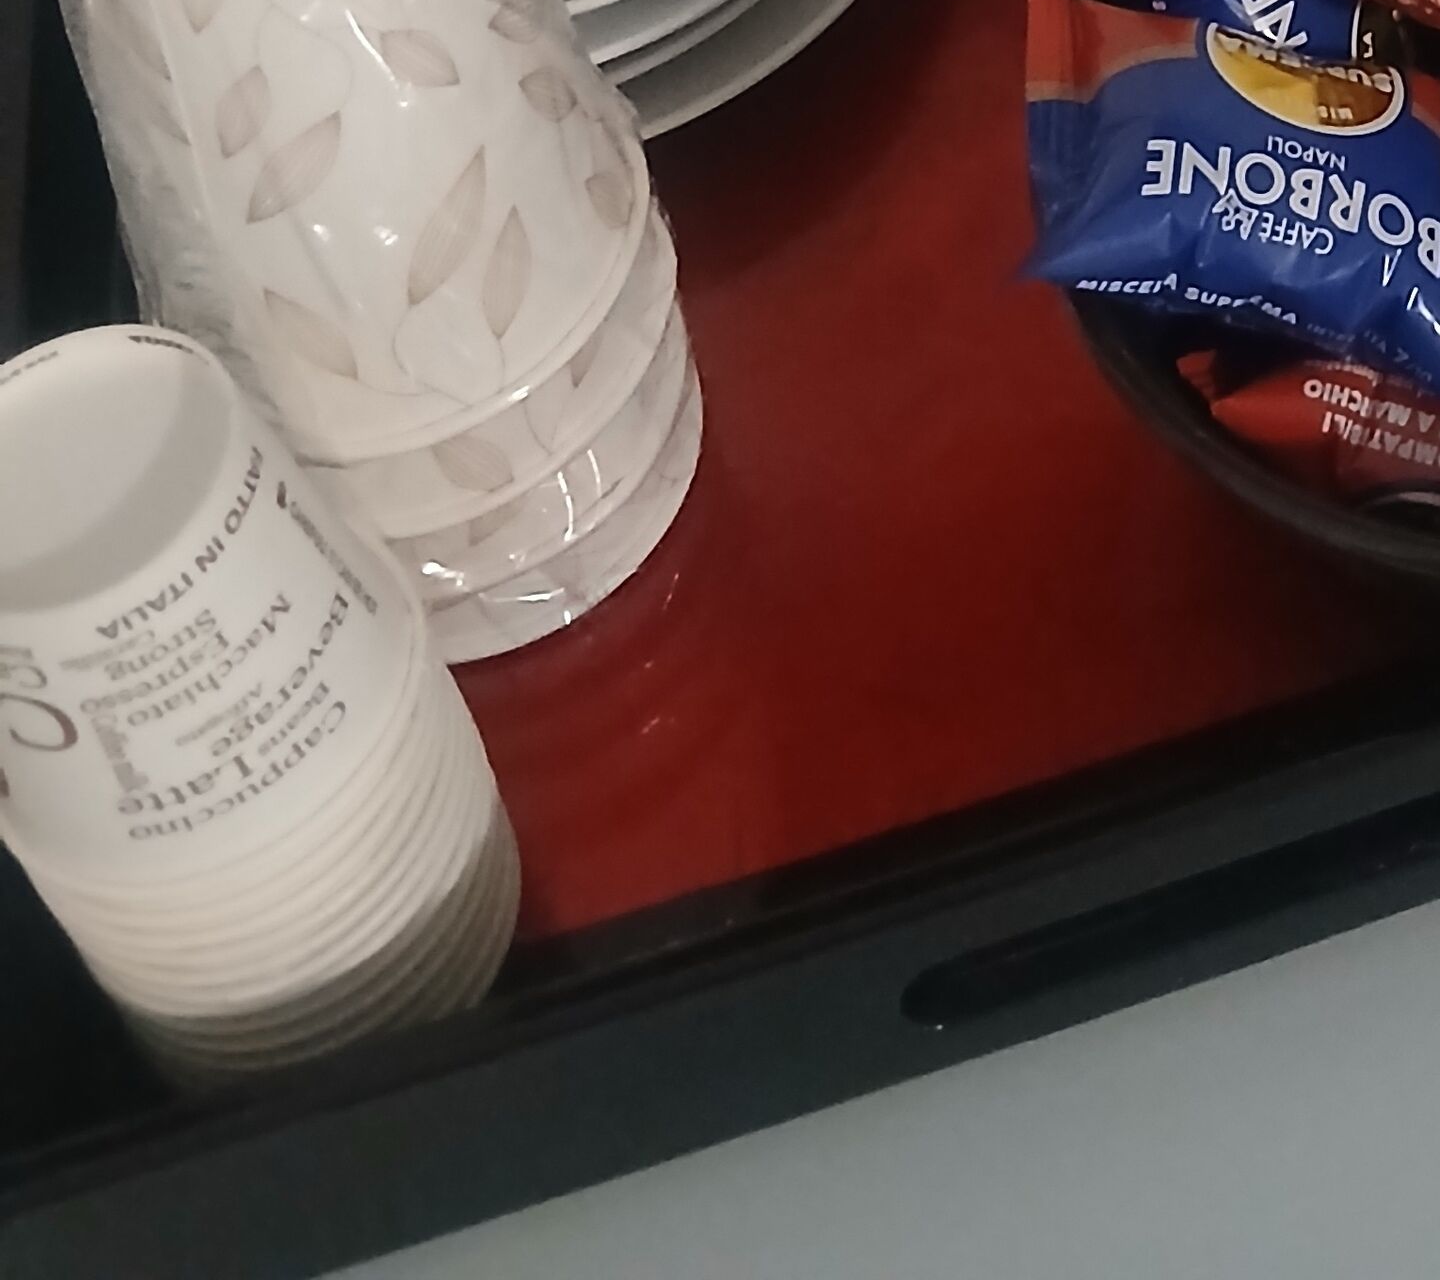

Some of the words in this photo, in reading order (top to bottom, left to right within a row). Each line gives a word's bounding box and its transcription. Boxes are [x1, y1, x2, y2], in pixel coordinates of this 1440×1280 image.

[1266, 135, 1346, 172] NAPOLI
[1257, 210, 1335, 255] CAFFÈ
[194, 535, 226, 573] IN
[95, 572, 194, 640] ITALIA
[80, 630, 230, 714] Espresso
[127, 593, 293, 728] Macchiato
[210, 592, 349, 758] Beverage
[257, 680, 330, 757] Beans
[117, 753, 254, 815] Latte
[128, 701, 347, 839] Cappuccino
